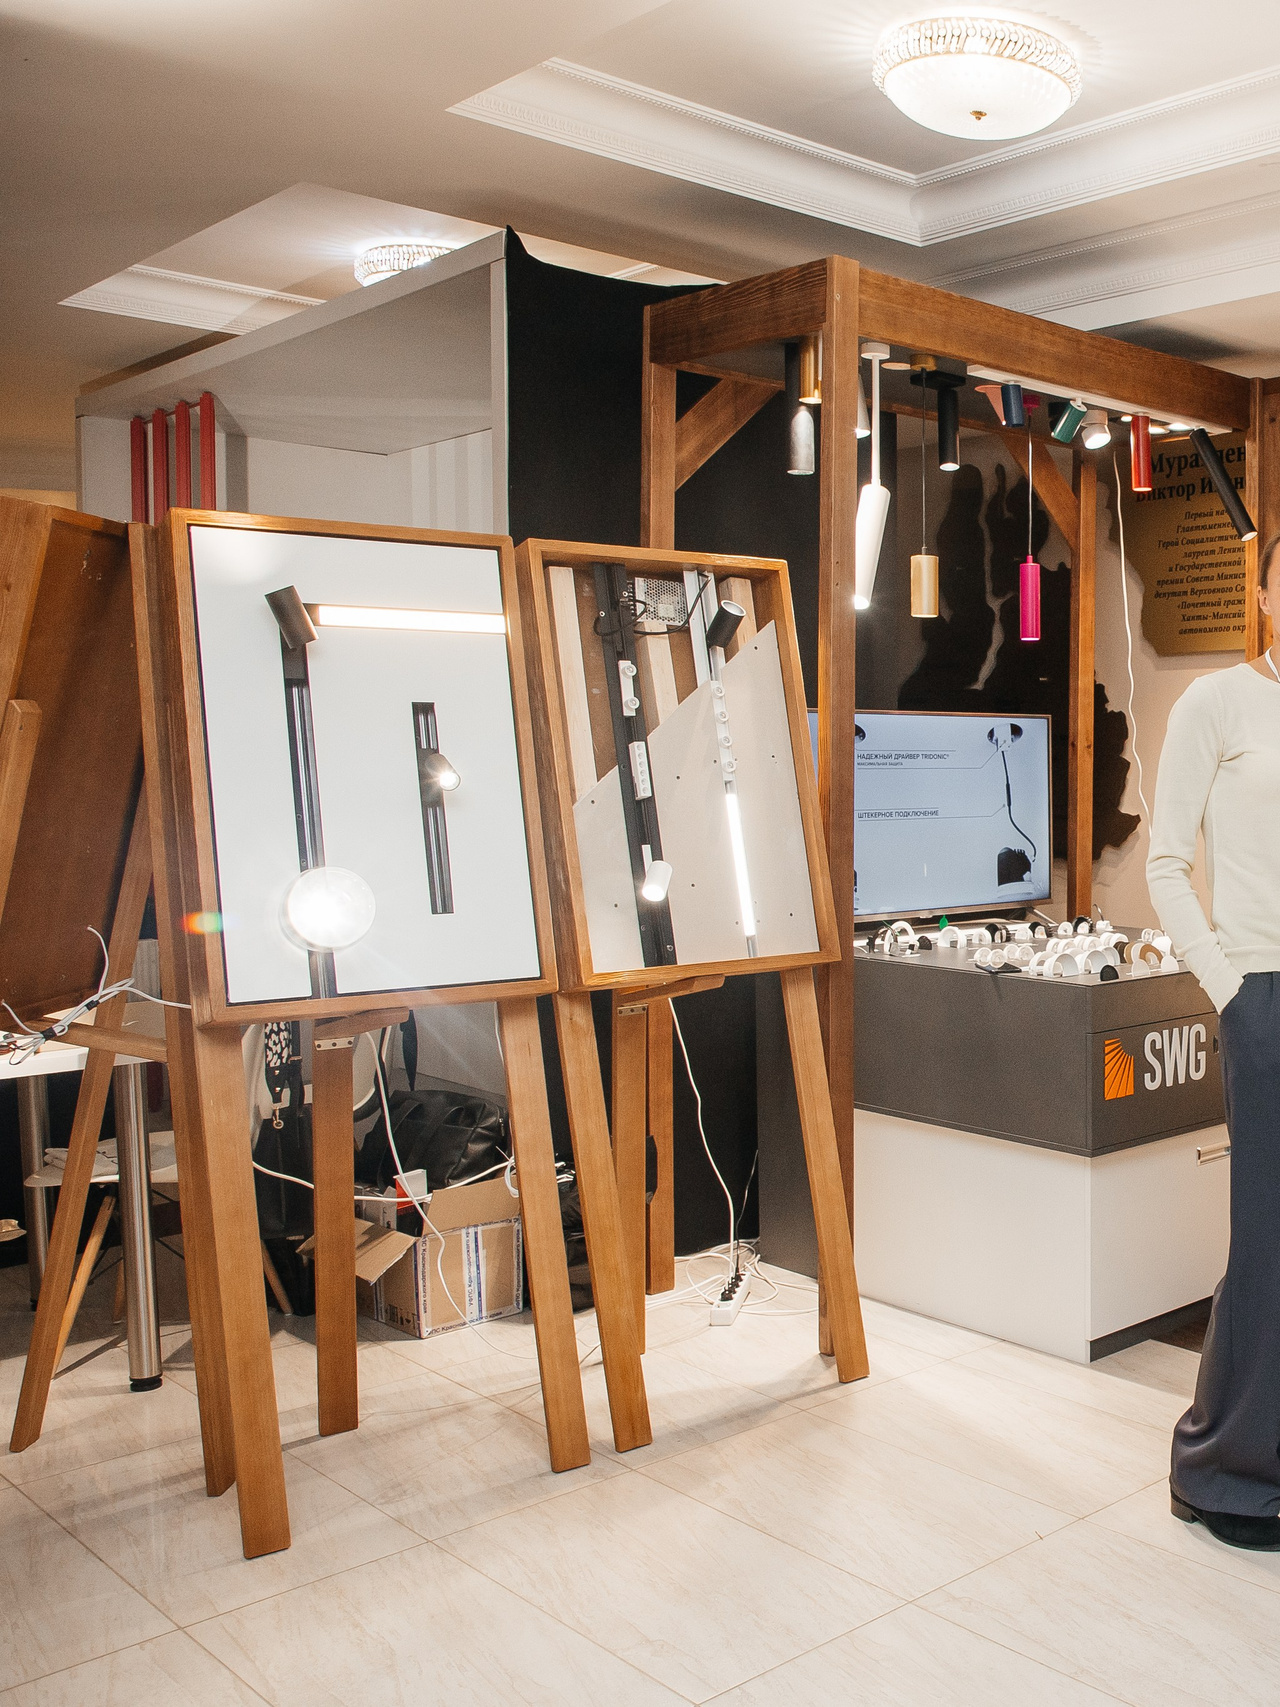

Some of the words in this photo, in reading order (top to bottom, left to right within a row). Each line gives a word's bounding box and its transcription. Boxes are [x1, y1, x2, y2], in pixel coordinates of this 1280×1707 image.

[1151, 446, 1246, 478] Мурален
[1184, 508, 1214, 521] Первый
[1158, 537, 1179, 550] Герой
[1181, 533, 1240, 547] Социалистиче
[1183, 549, 1216, 560] лауреат
[1174, 557, 1242, 572] Государственной
[1156, 578, 1184, 588] премии
[1186, 575, 1215, 584] Совета
[1154, 589, 1188, 600] депутат
[1190, 586, 1234, 597] Верховного
[1234, 583, 1246, 592] Со
[1181, 610, 1246, 622] Ханты-Мансийс
[1178, 624, 1231, 635] автономного
[857, 811, 893, 819] ШТЕКЕРНОЕ
[895, 810, 939, 818] ПОДКЛЮЧЕНИЕ
[1144, 1023, 1207, 1091] SWG
